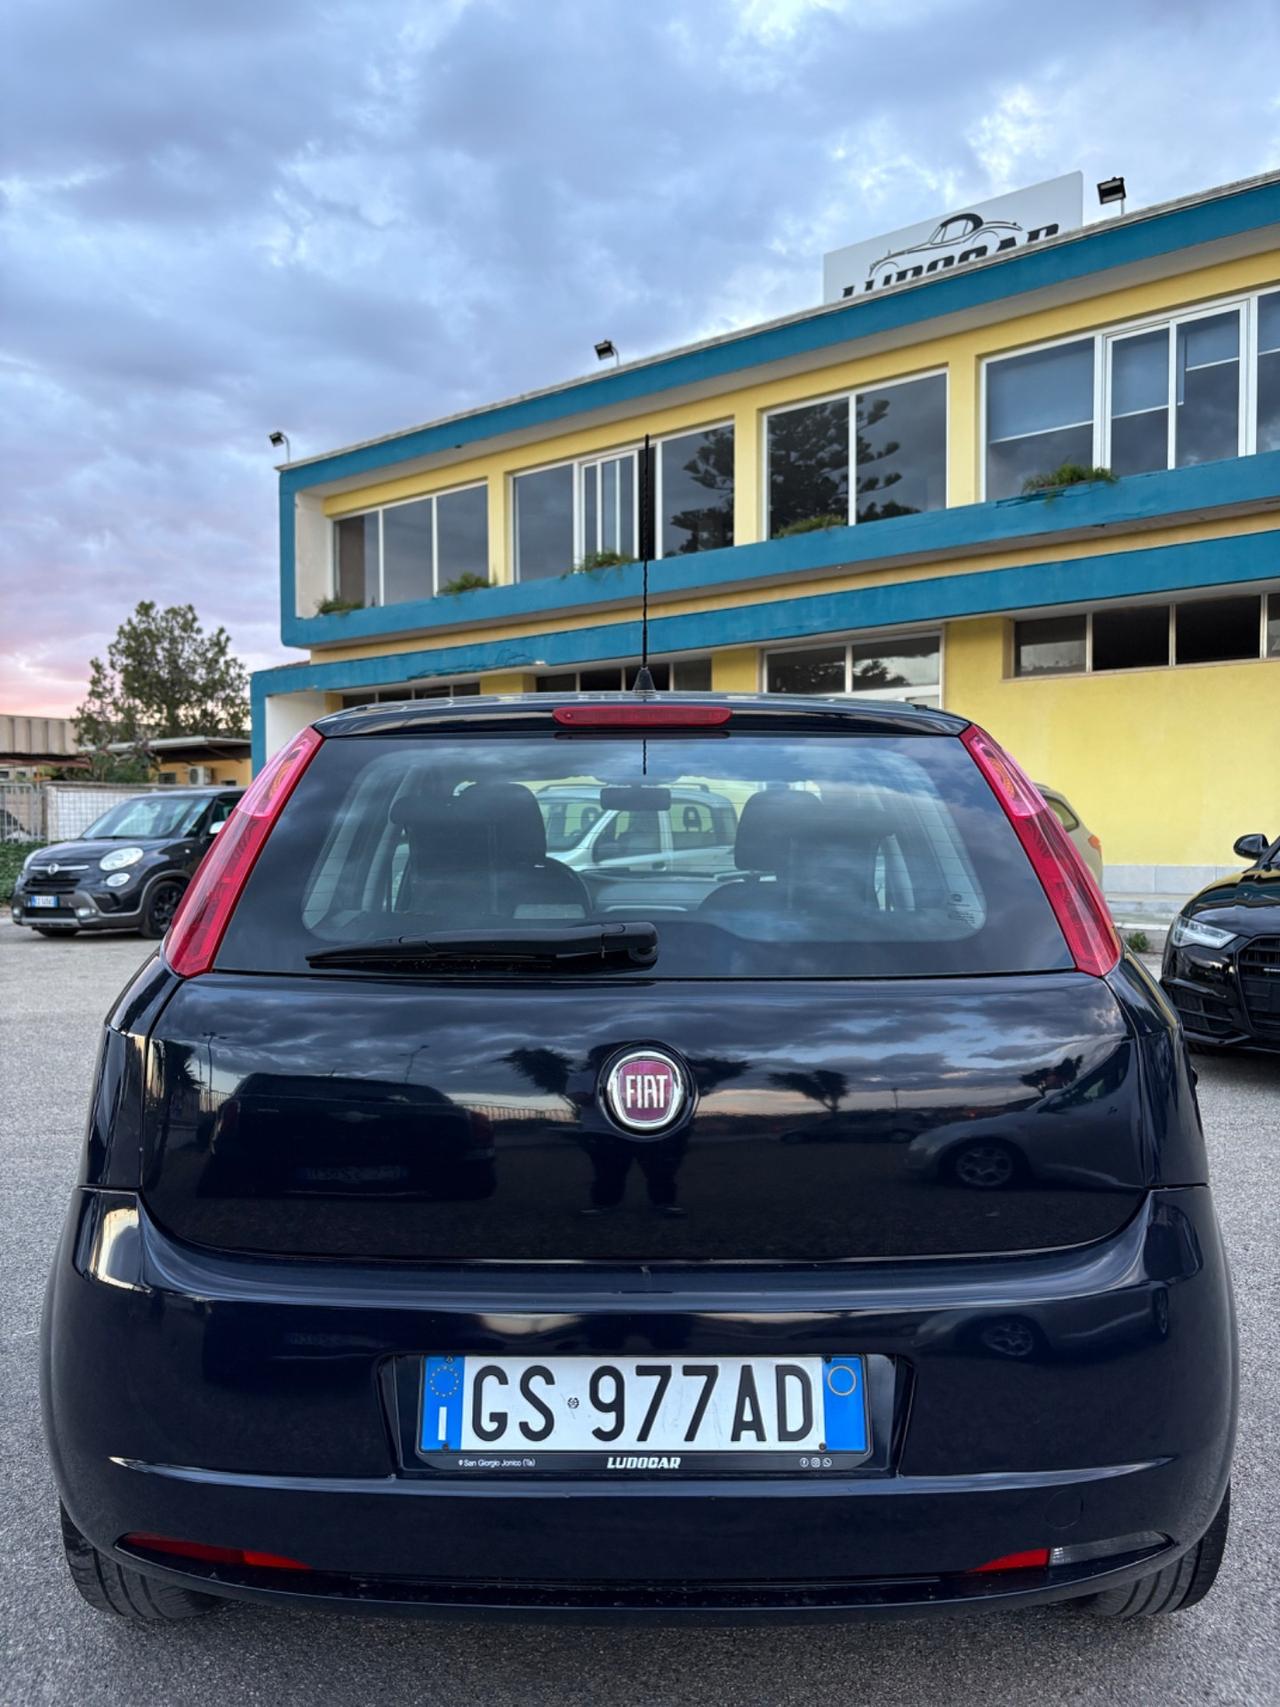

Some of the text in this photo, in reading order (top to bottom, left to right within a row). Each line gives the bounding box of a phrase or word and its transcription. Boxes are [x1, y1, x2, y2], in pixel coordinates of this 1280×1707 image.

[625, 1075, 668, 1109] FIAT
[472, 1364, 556, 1442] GS
[588, 1364, 814, 1442] 977AD
[463, 1459, 477, 1467] San
[477, 1459, 500, 1468] Giorgio
[501, 1459, 522, 1467] Jonico
[606, 1457, 681, 1469] LUDOCAR
